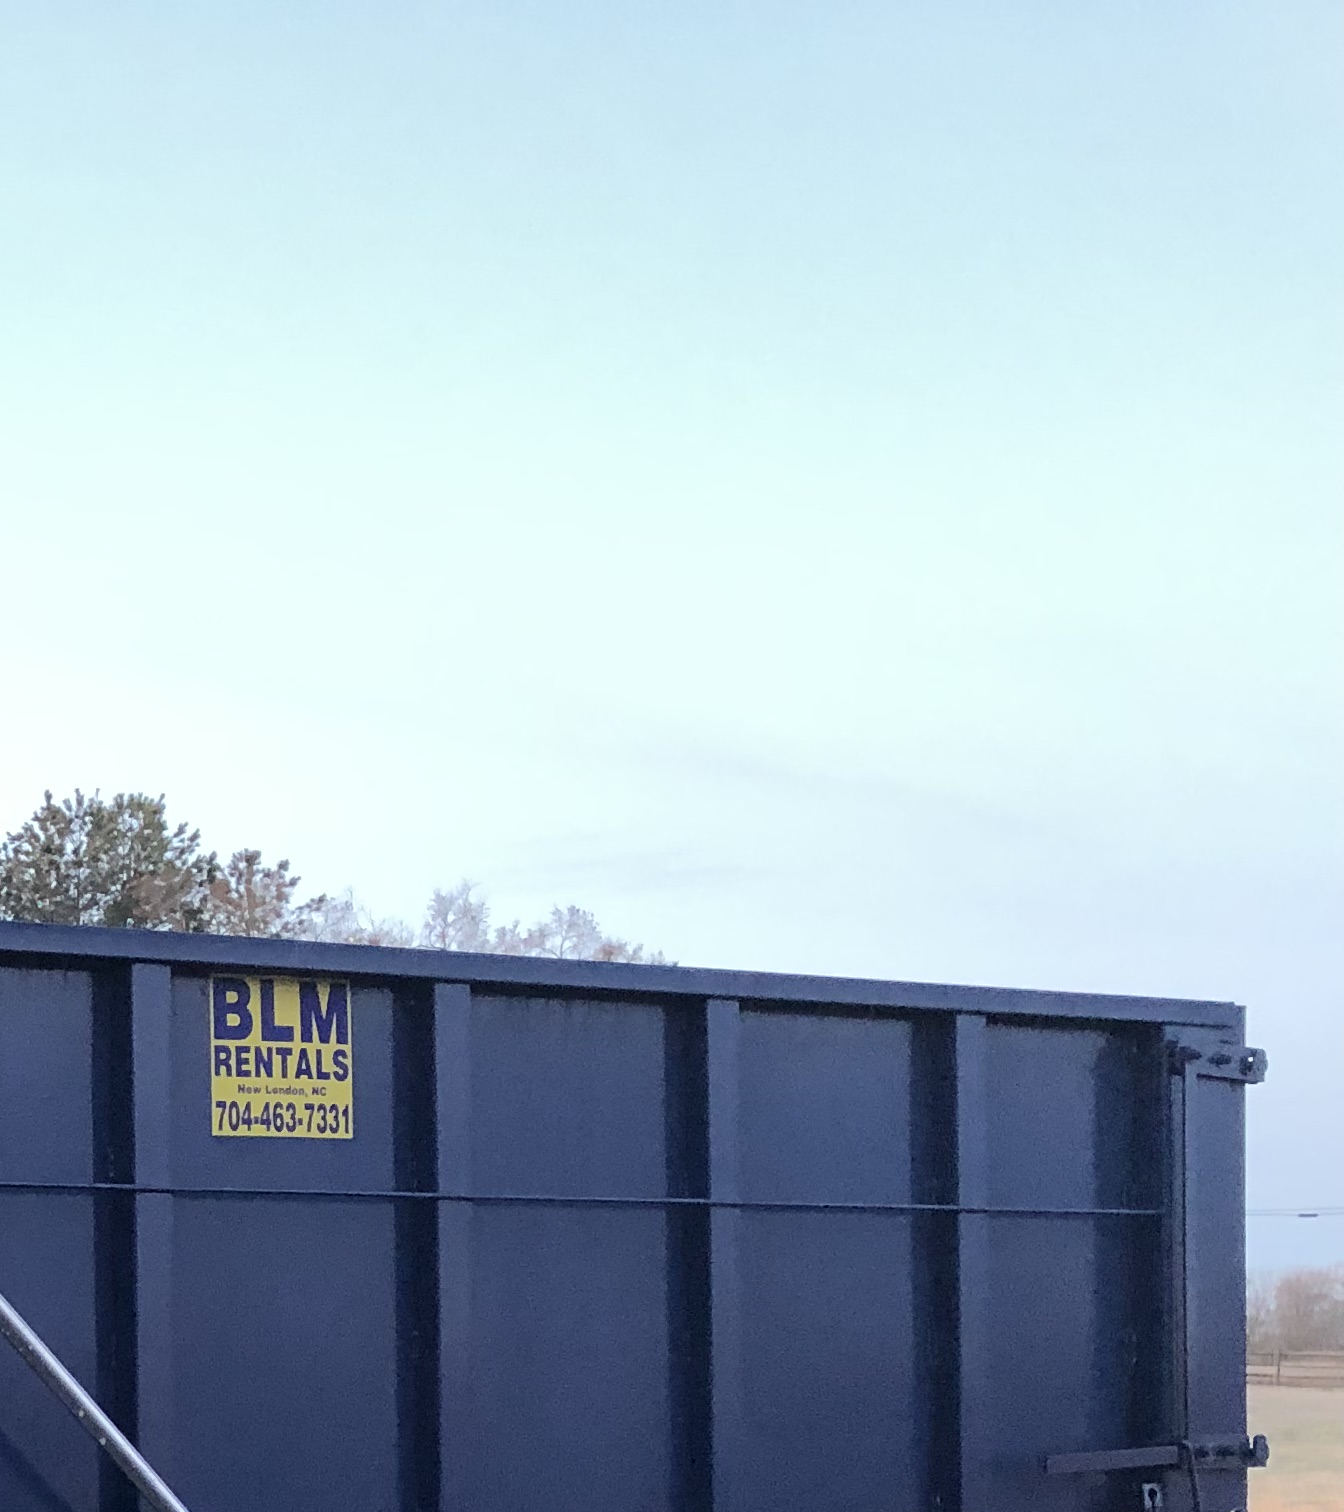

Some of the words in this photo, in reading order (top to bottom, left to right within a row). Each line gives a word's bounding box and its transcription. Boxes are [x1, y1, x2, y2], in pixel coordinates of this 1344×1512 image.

[213, 977, 349, 1045] BLM
[214, 1045, 350, 1081] RENTALS
[238, 1084, 262, 1094] New
[265, 1085, 308, 1098] London,
[312, 1086, 327, 1096] NC
[216, 1101, 350, 1134] 704-463-7331
